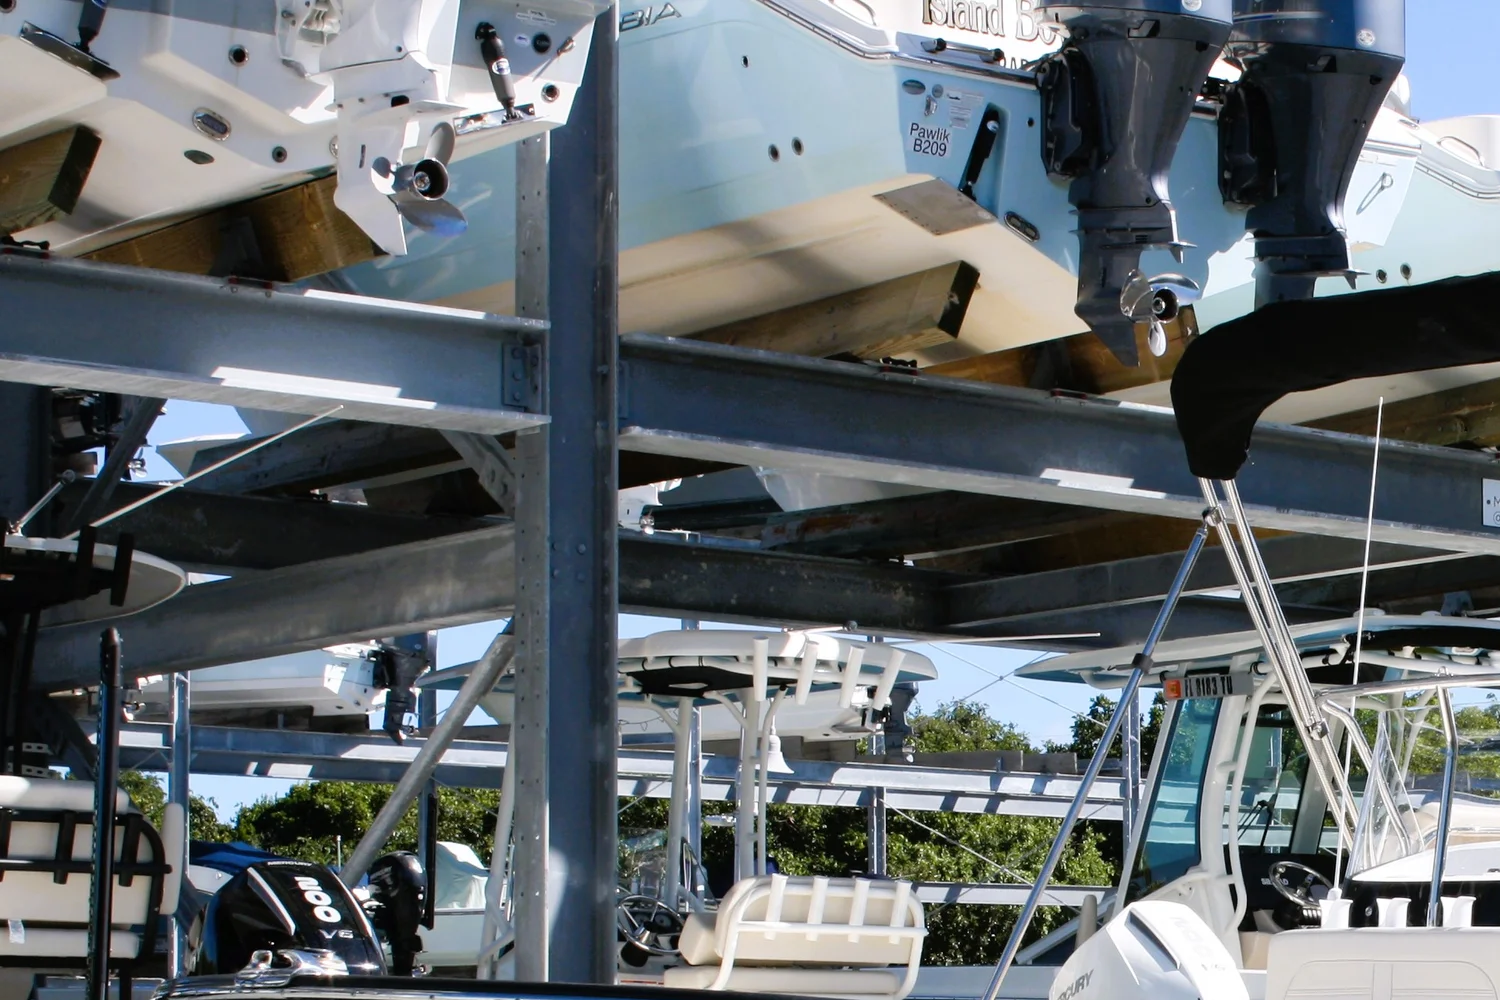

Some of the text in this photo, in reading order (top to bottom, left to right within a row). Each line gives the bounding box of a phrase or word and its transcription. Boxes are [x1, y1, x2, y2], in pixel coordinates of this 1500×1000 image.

[922, 0, 1006, 37] Island
[910, 122, 951, 144] Pawlik
[913, 138, 947, 158] B209
[294, 876, 342, 924] 200
